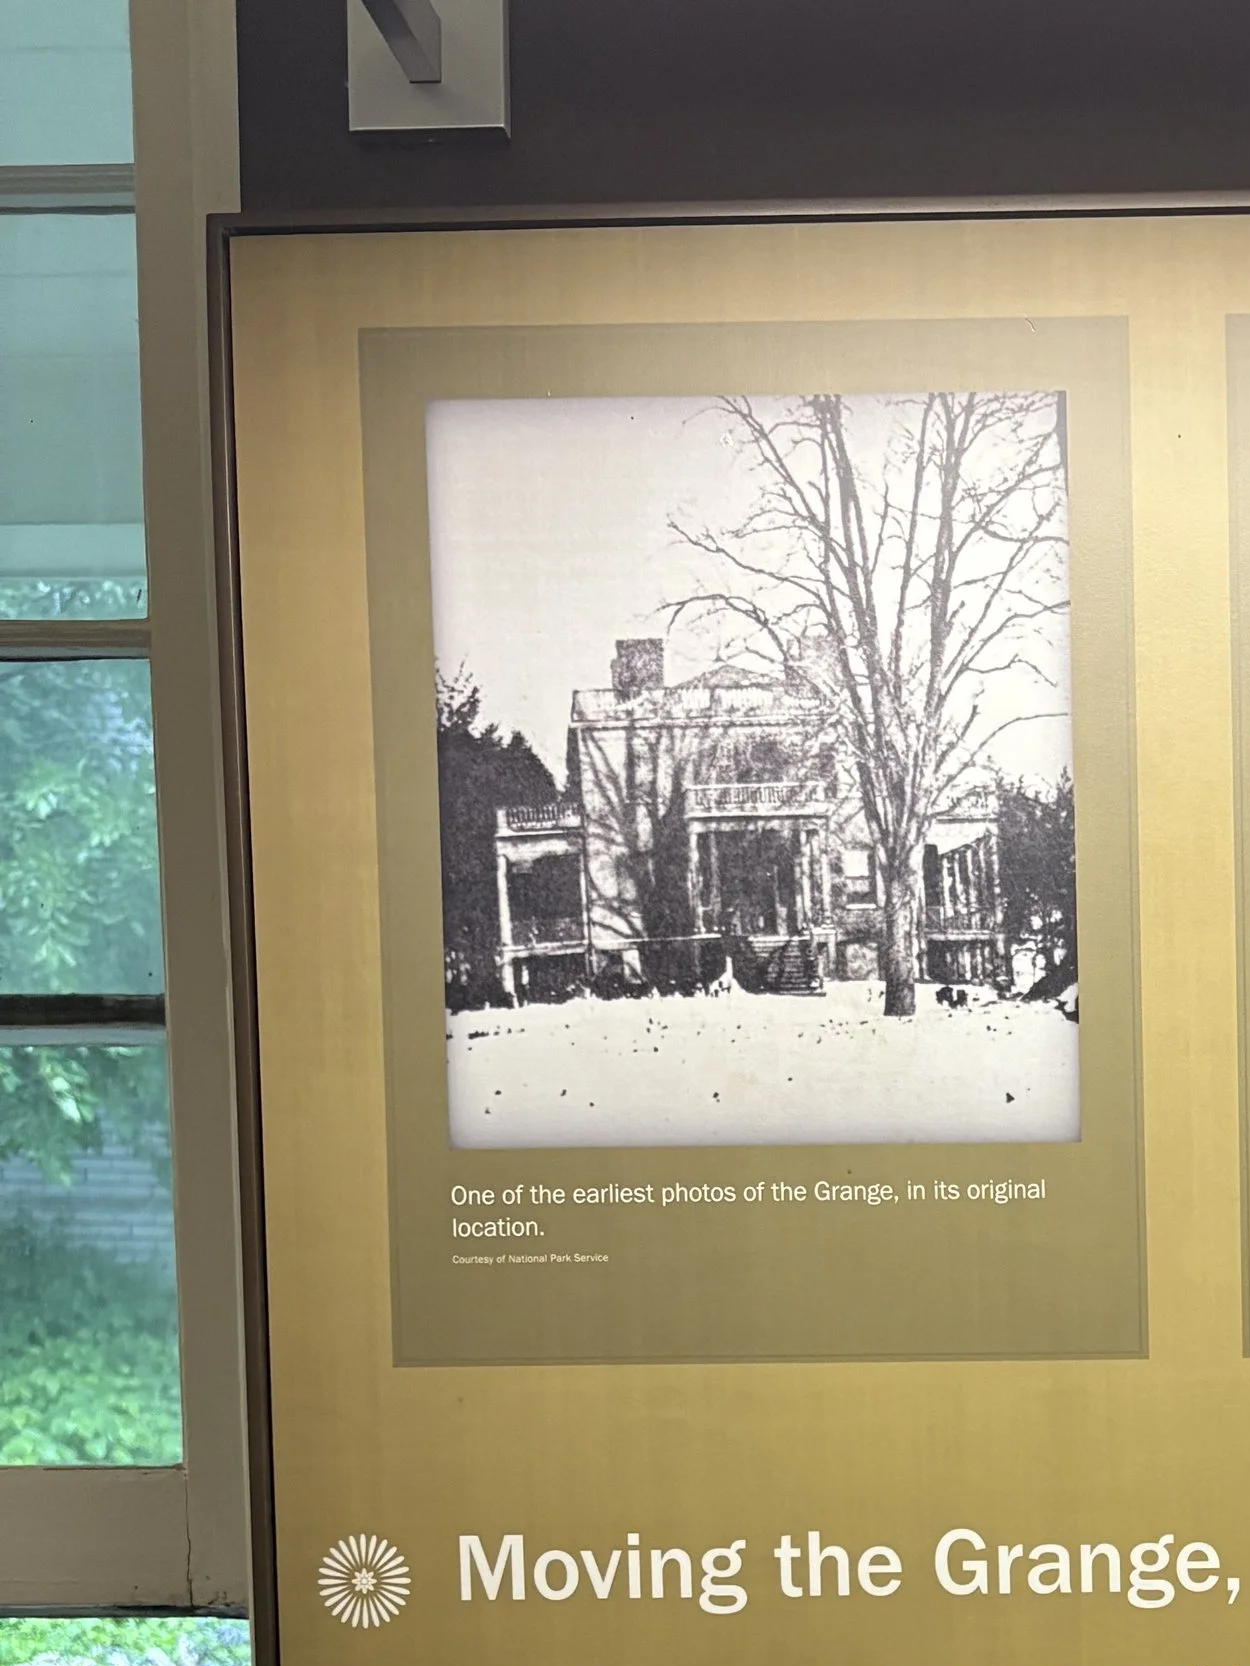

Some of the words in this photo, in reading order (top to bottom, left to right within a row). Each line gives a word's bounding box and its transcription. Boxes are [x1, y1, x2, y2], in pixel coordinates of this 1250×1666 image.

[451, 1185, 495, 1205] One
[502, 1184, 524, 1204] of
[530, 1185, 565, 1204] the
[573, 1184, 655, 1203] earliest
[662, 1183, 736, 1206] photos
[744, 1182, 765, 1201] of
[771, 1182, 806, 1201] the
[814, 1181, 898, 1205] Grange,
[908, 1181, 925, 1200] in
[934, 1180, 960, 1200] its
[967, 1179, 1045, 1204] original
[453, 1217, 544, 1237] location.
[452, 1255, 494, 1265] Courtesy
[496, 1255, 506, 1263] of
[508, 1254, 547, 1263] National
[550, 1254, 571, 1262] Park
[574, 1253, 609, 1262] Service
[459, 1533, 747, 1614] Moving
[774, 1531, 902, 1597] the
[935, 1529, 1240, 1608] Grange,
